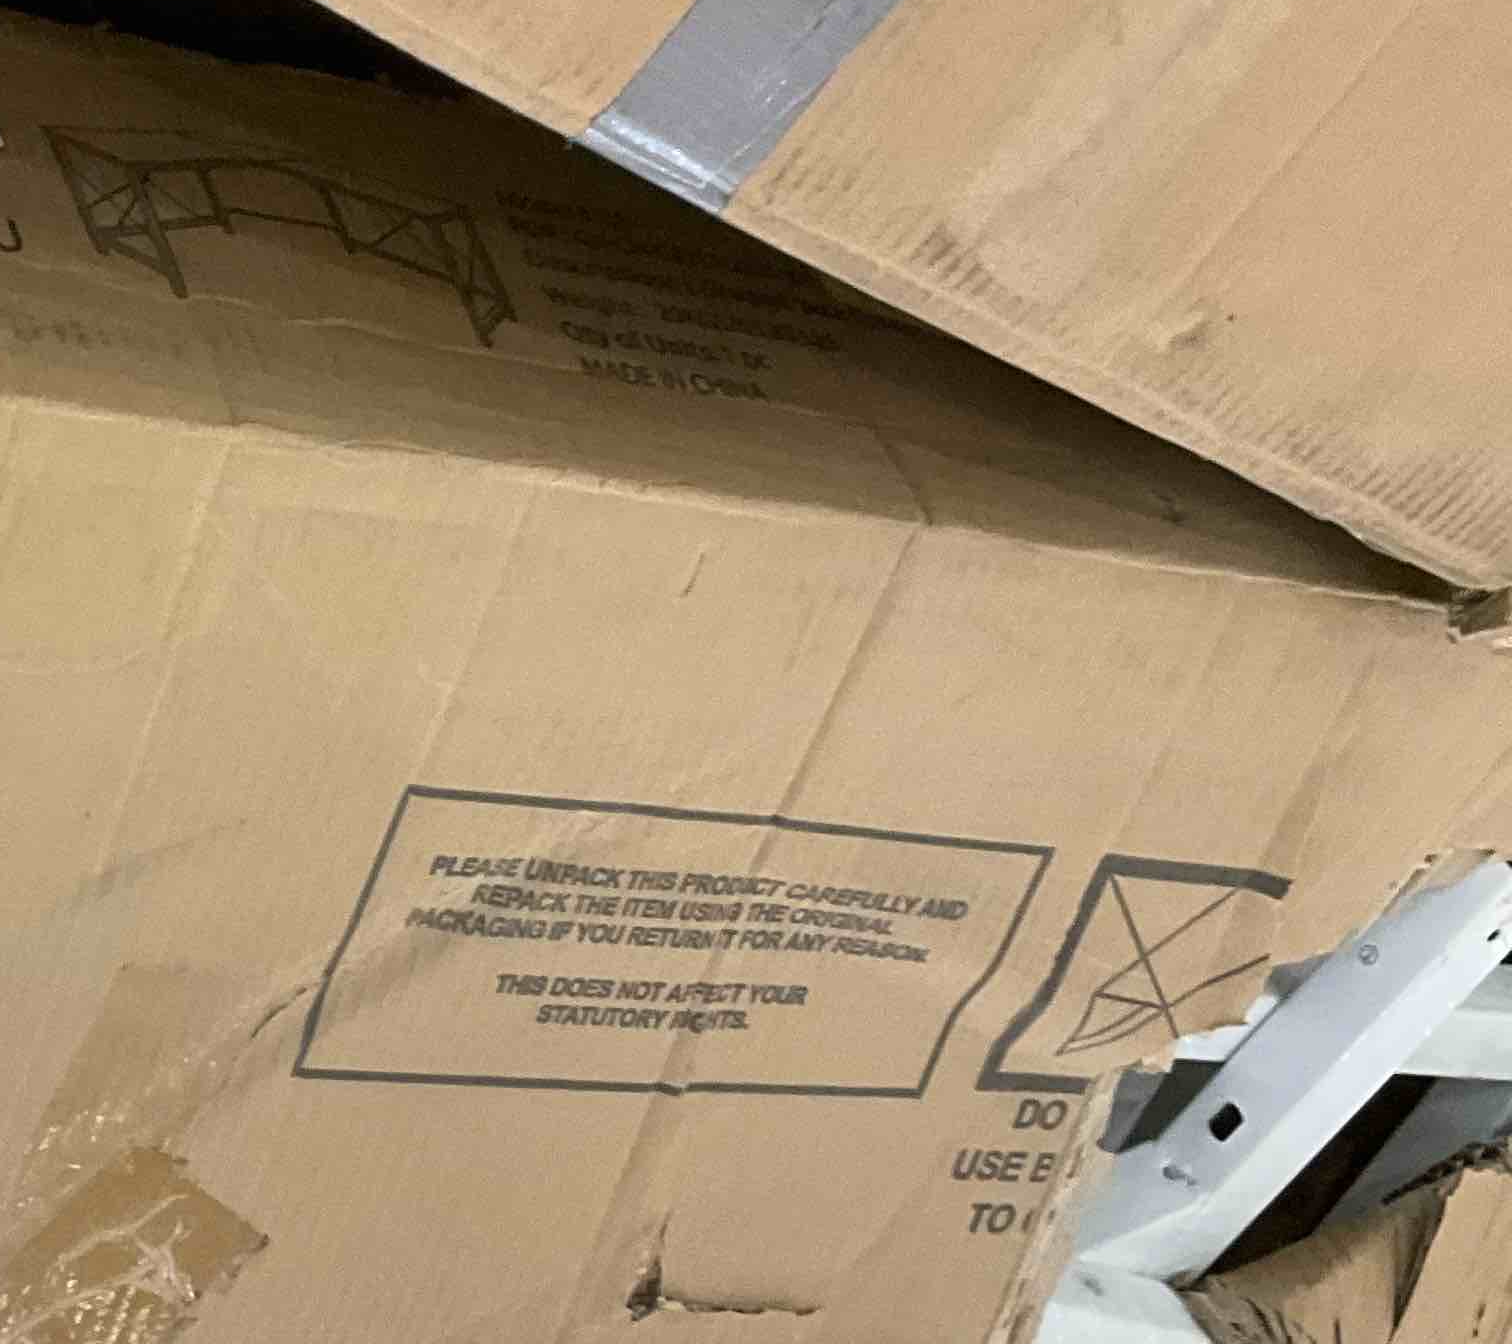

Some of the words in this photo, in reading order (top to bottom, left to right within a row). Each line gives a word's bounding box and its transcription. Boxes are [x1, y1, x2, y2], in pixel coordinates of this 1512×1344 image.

[429, 854, 521, 878] PLEASE
[524, 856, 624, 889] UNPACK
[627, 869, 678, 891] THIS
[679, 872, 786, 898] PRODUCT
[786, 883, 921, 916] CAREFULLY
[920, 898, 969, 921] AND
[470, 883, 571, 913] REPACK
[573, 893, 621, 916] THE
[621, 898, 678, 919] ITEM
[678, 902, 743, 923] USING
[745, 904, 790, 924] THE
[789, 907, 893, 935] ORIGINAL
[404, 907, 547, 940] PACKAGING
[547, 920, 574, 941] IF
[576, 922, 626, 945] YOU
[625, 925, 714, 949] RETURN
[716, 928, 738, 950] IT
[739, 929, 784, 951] FOR
[785, 930, 835, 953] ANY
[495, 973, 548, 996] THIS
[549, 976, 615, 998] DOES
[615, 980, 667, 1001] NOT
[665, 982, 746, 1004] AFFECT
[749, 984, 809, 1006] YOUR
[535, 1004, 672, 1030] STATUTORY
[1011, 1098, 1069, 1131] DO
[951, 1148, 1029, 1182] USE
[968, 1202, 1017, 1234] TO
